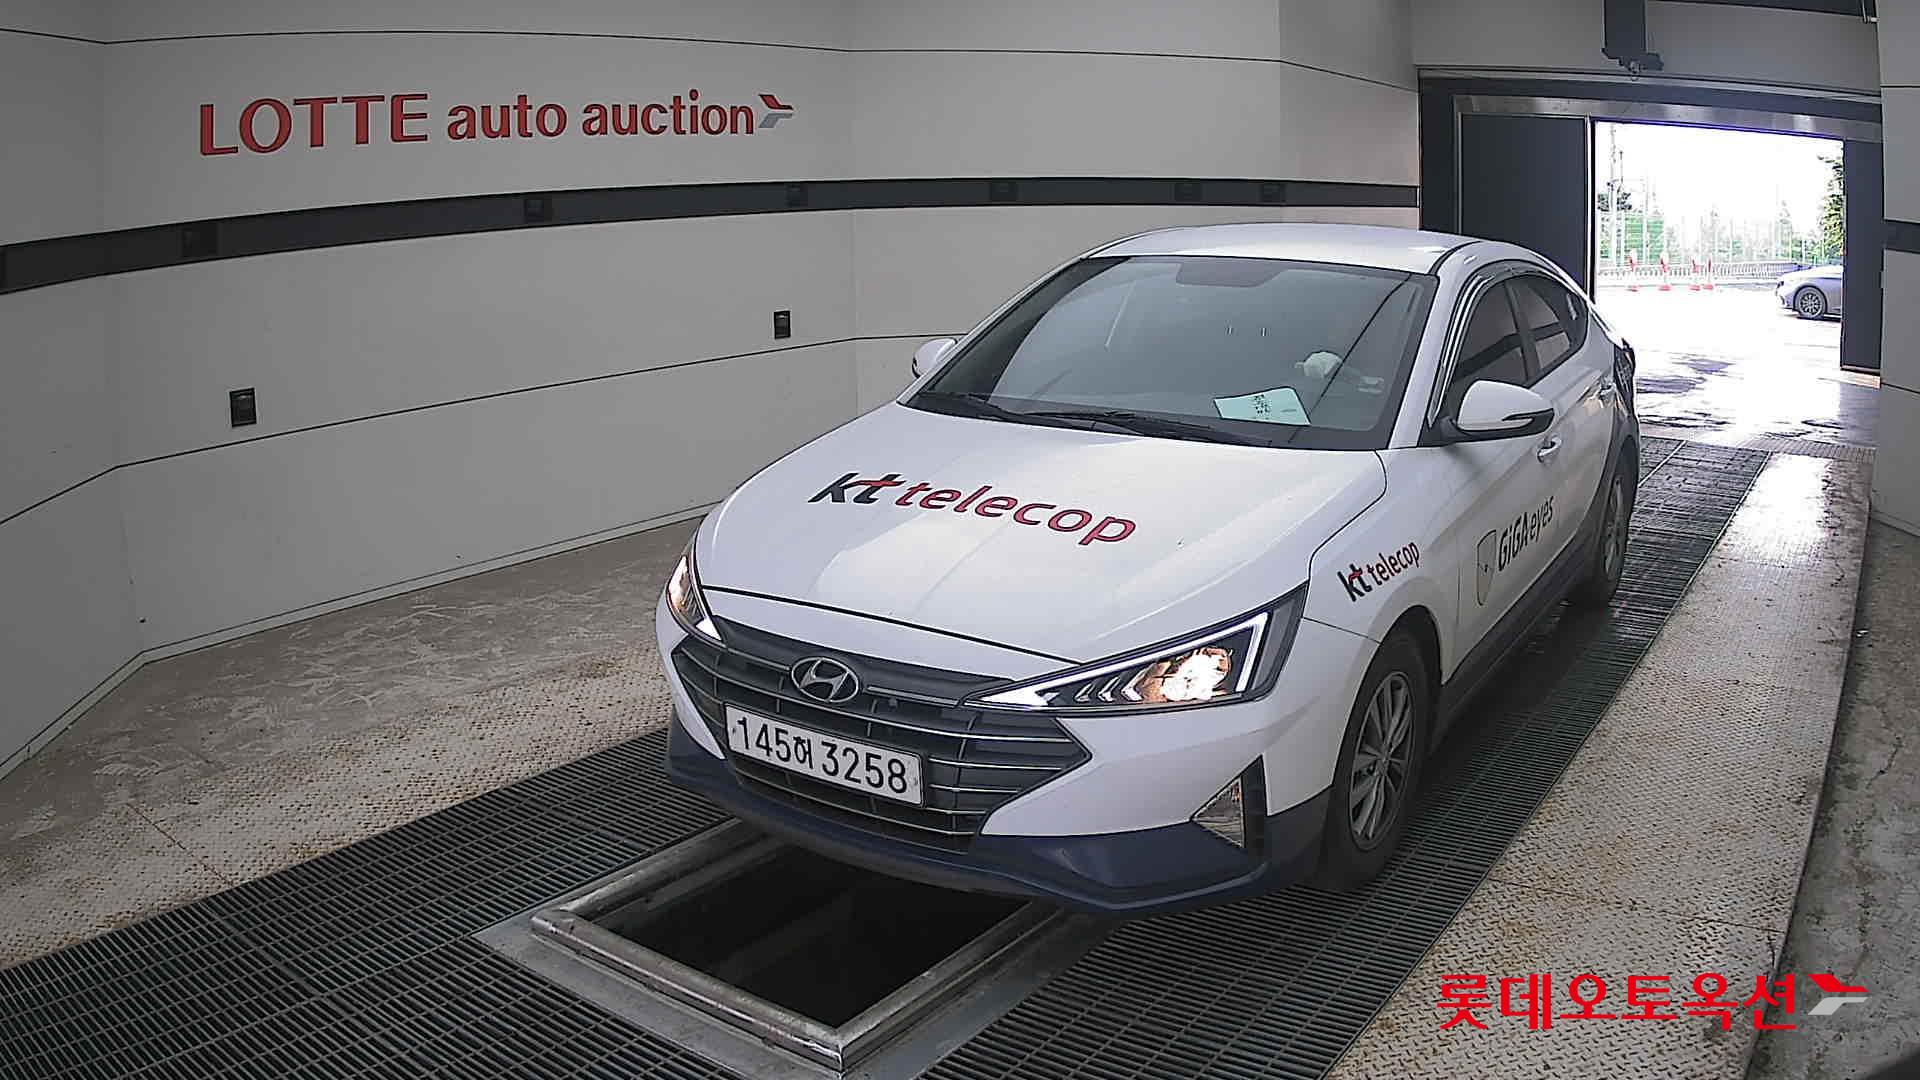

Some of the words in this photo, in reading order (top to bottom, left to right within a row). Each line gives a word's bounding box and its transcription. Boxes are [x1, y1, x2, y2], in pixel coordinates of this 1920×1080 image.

[200, 93, 429, 155] LOTTE
[447, 94, 568, 139] auto
[582, 89, 754, 136] auction
[808, 473, 906, 504] kt
[895, 482, 1136, 546] telecop
[1337, 564, 1372, 602] kt
[1367, 541, 1420, 587] telecop
[821, 740, 907, 794] 3258
